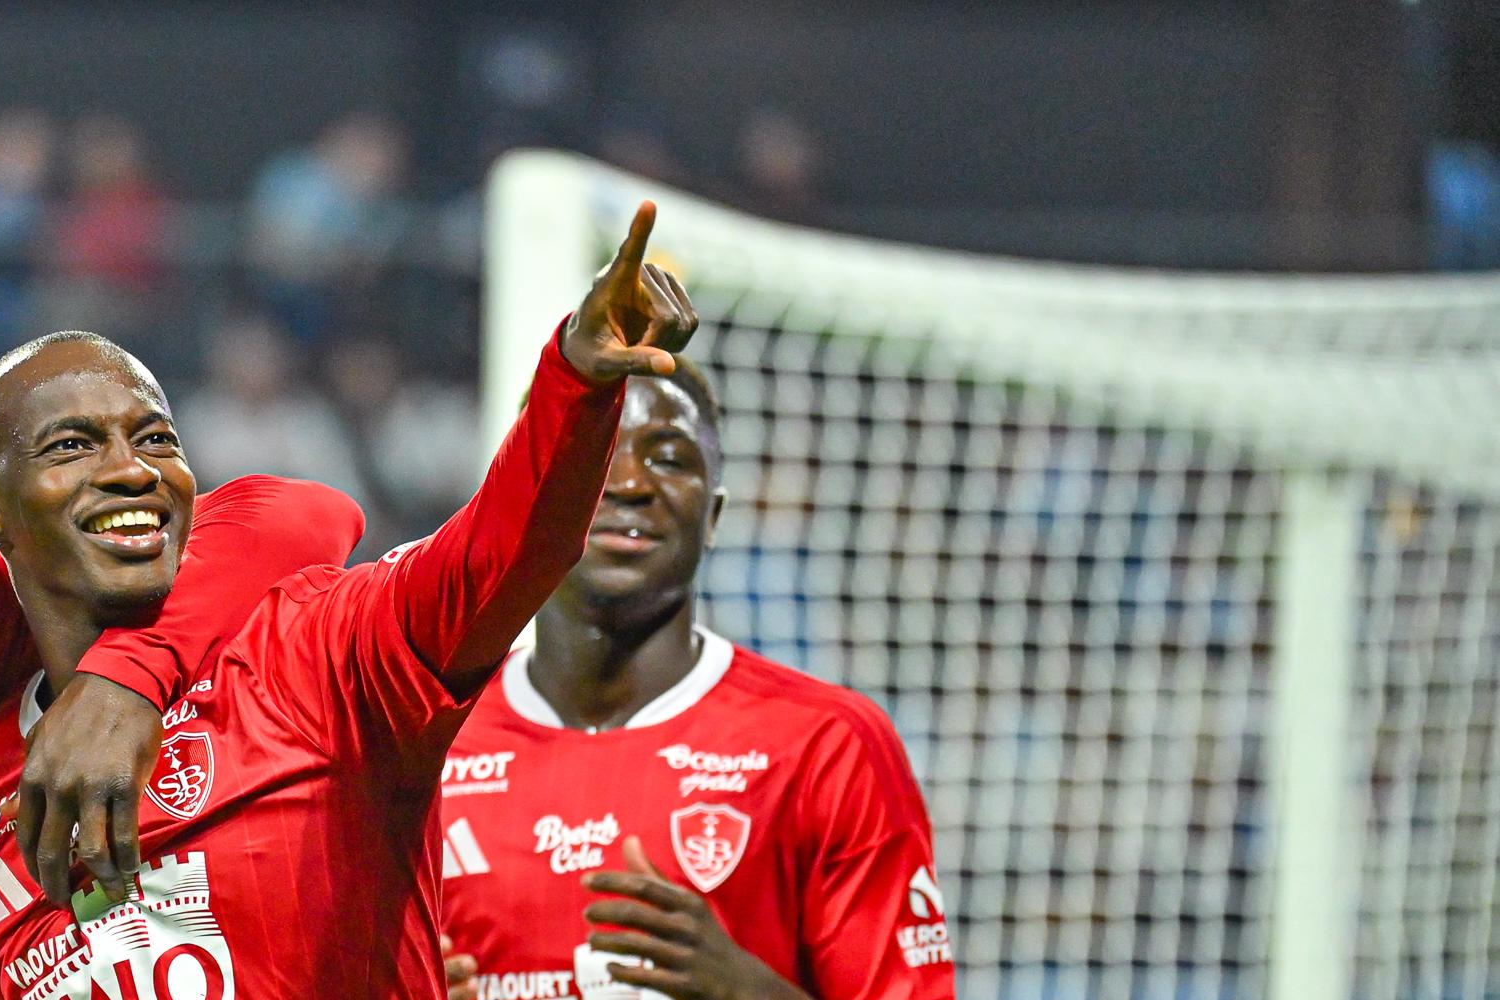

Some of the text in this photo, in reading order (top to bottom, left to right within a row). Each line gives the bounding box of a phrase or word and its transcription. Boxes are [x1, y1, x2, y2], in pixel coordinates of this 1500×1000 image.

[162, 700, 198, 730] tels
[656, 744, 769, 772] Oceania
[157, 765, 206, 799] SB
[533, 813, 620, 853] Breizh
[550, 844, 604, 874] Cola
[4, 923, 78, 989] YAOURT
